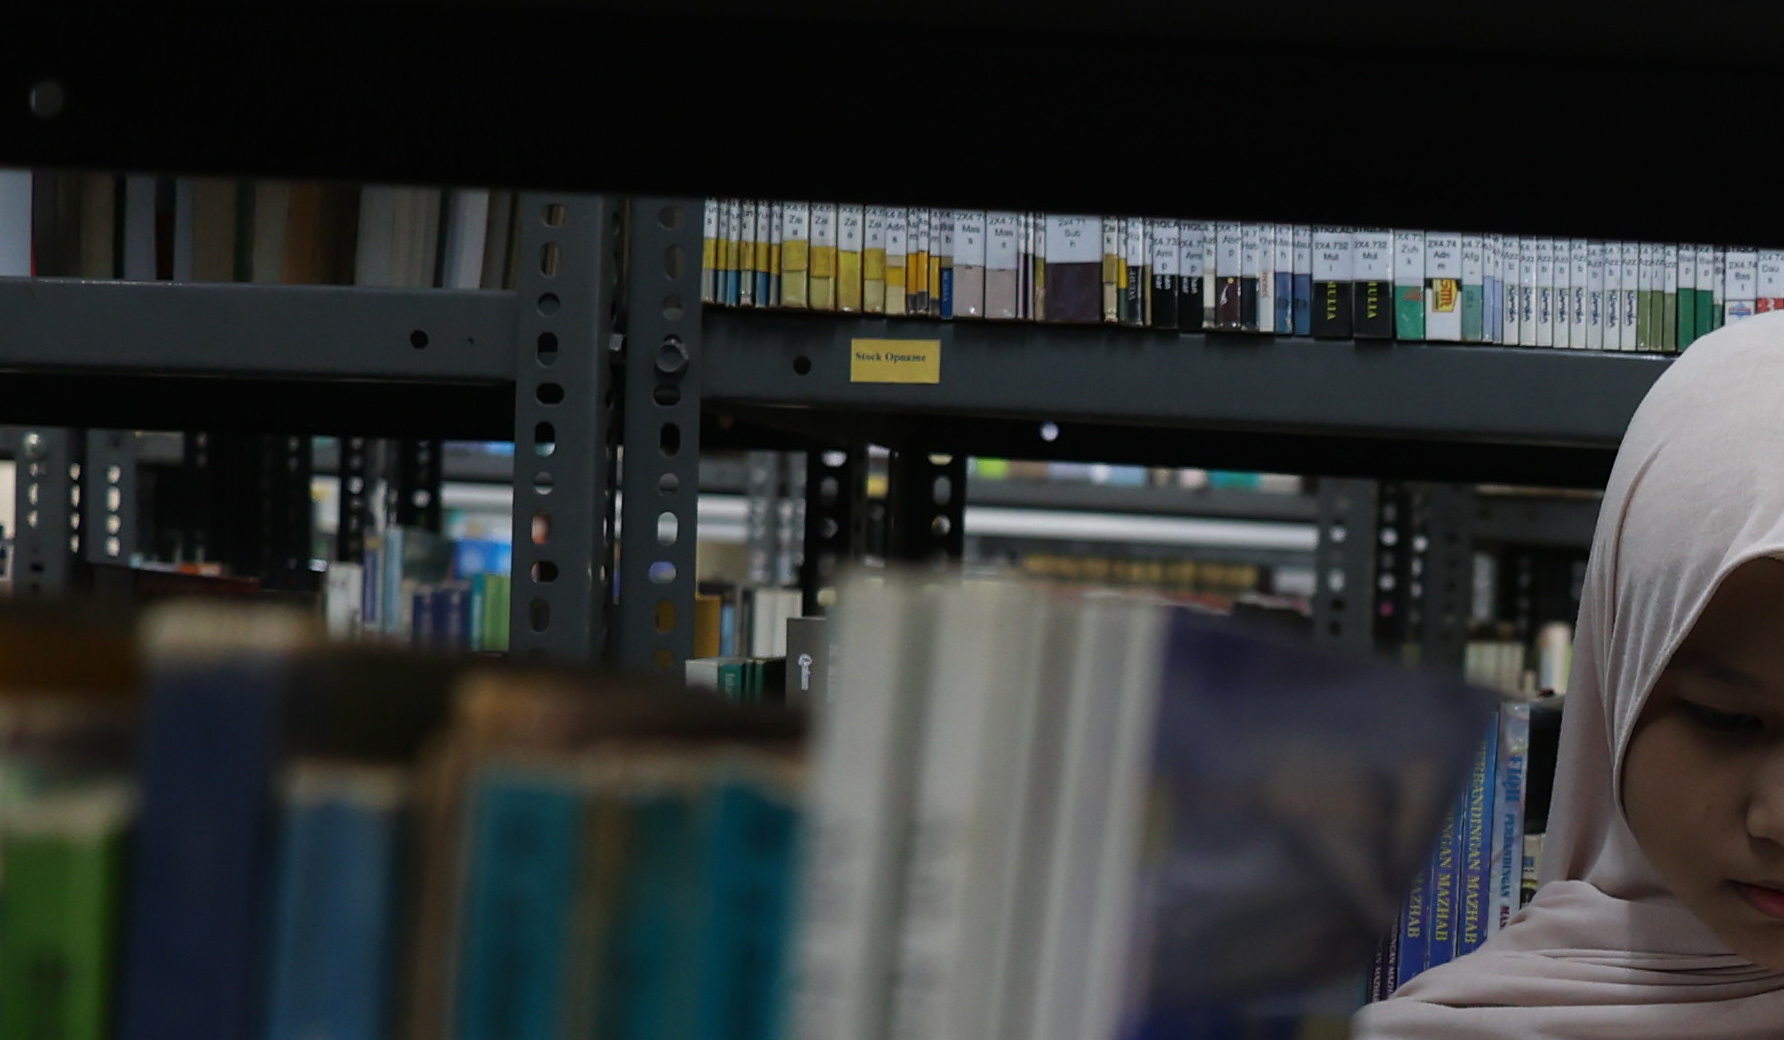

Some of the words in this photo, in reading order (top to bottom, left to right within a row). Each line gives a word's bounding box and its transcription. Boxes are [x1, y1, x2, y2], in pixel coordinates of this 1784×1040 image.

[1500, 814, 1515, 898] PERBANDINGAN
[1435, 874, 1452, 941] MAZHAB
[1465, 875, 1482, 944] MAZHAB
